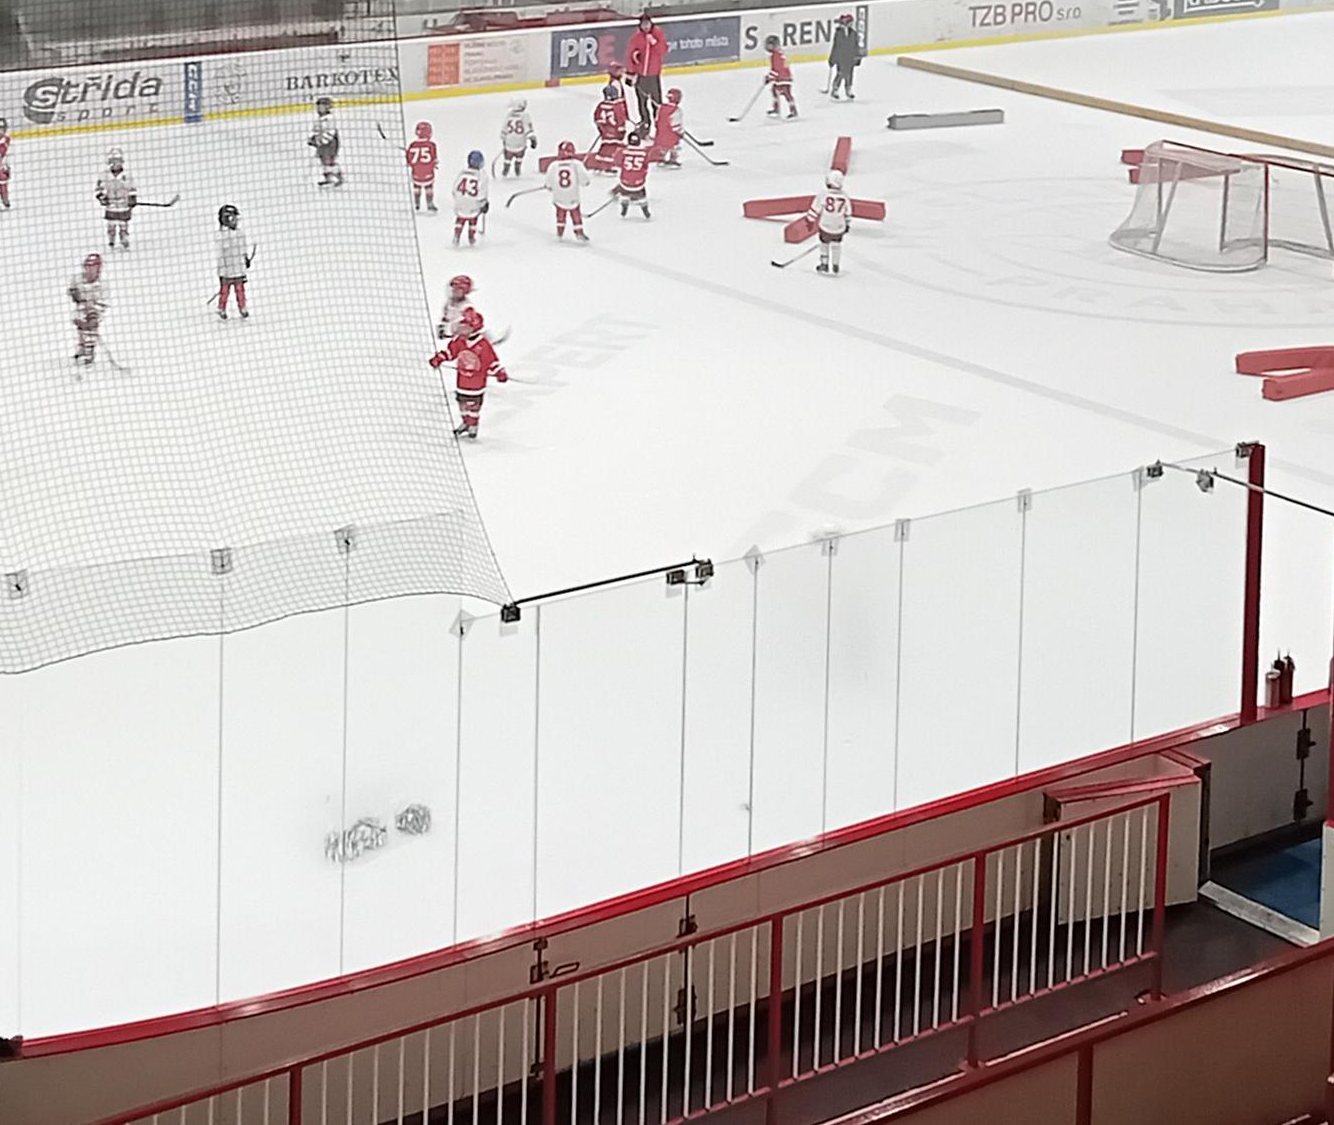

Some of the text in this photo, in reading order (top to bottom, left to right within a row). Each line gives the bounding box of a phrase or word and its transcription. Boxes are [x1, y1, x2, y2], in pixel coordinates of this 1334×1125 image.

[968, 4, 1008, 27] TZB
[1010, 0, 1054, 24] PRO
[559, 34, 616, 68] PRE
[285, 65, 399, 91] BARKOTEX
[409, 147, 432, 164] 75
[623, 156, 645, 171] 55
[456, 177, 479, 197] 43
[558, 169, 572, 188] 8
[825, 196, 846, 213] 87
